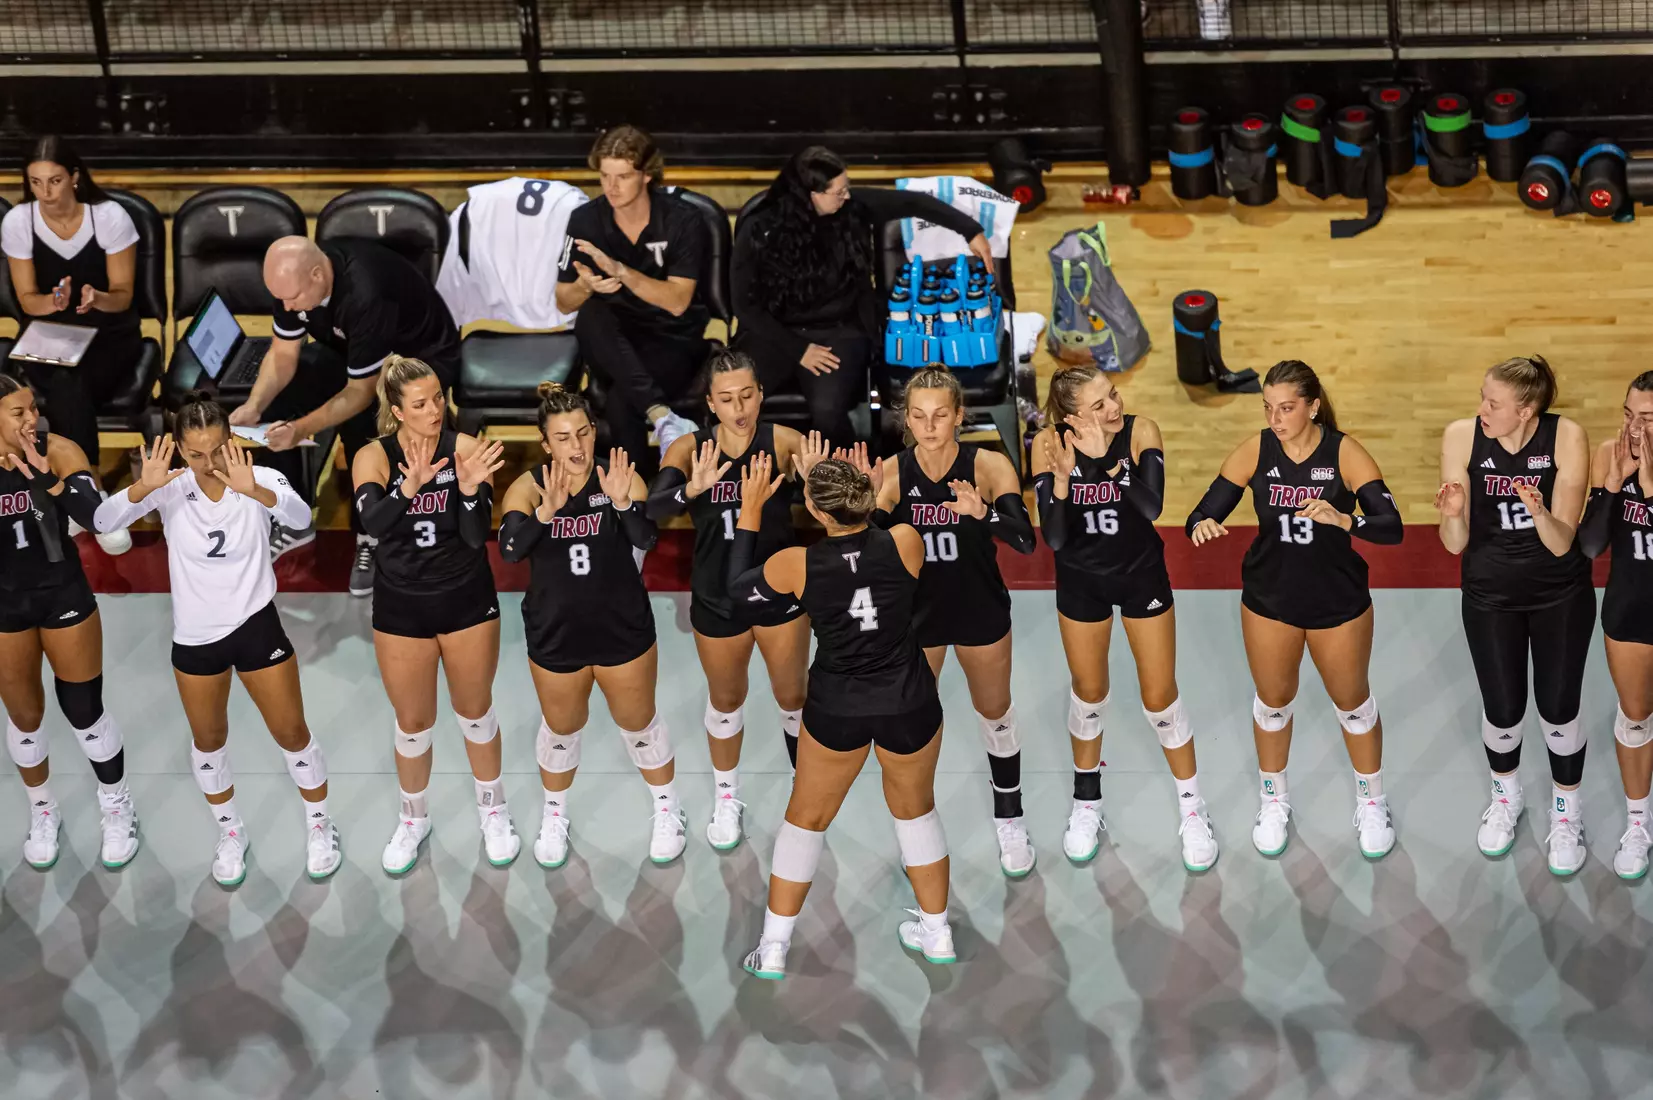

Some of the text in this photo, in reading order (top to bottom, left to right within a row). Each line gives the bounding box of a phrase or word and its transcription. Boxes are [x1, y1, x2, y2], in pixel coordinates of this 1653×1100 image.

[516, 180, 550, 216] 8
[1310, 467, 1335, 480] SBC
[551, 512, 602, 538] TROY
[1083, 508, 1119, 535] 16
[1278, 513, 1314, 544] 13
[1497, 502, 1534, 530] 12
[12, 520, 29, 549] 1
[207, 530, 226, 557] 2
[413, 520, 436, 547] 3
[923, 531, 958, 562] 10
[569, 543, 591, 575] 8
[841, 551, 861, 573] T
[847, 587, 878, 631] 4
